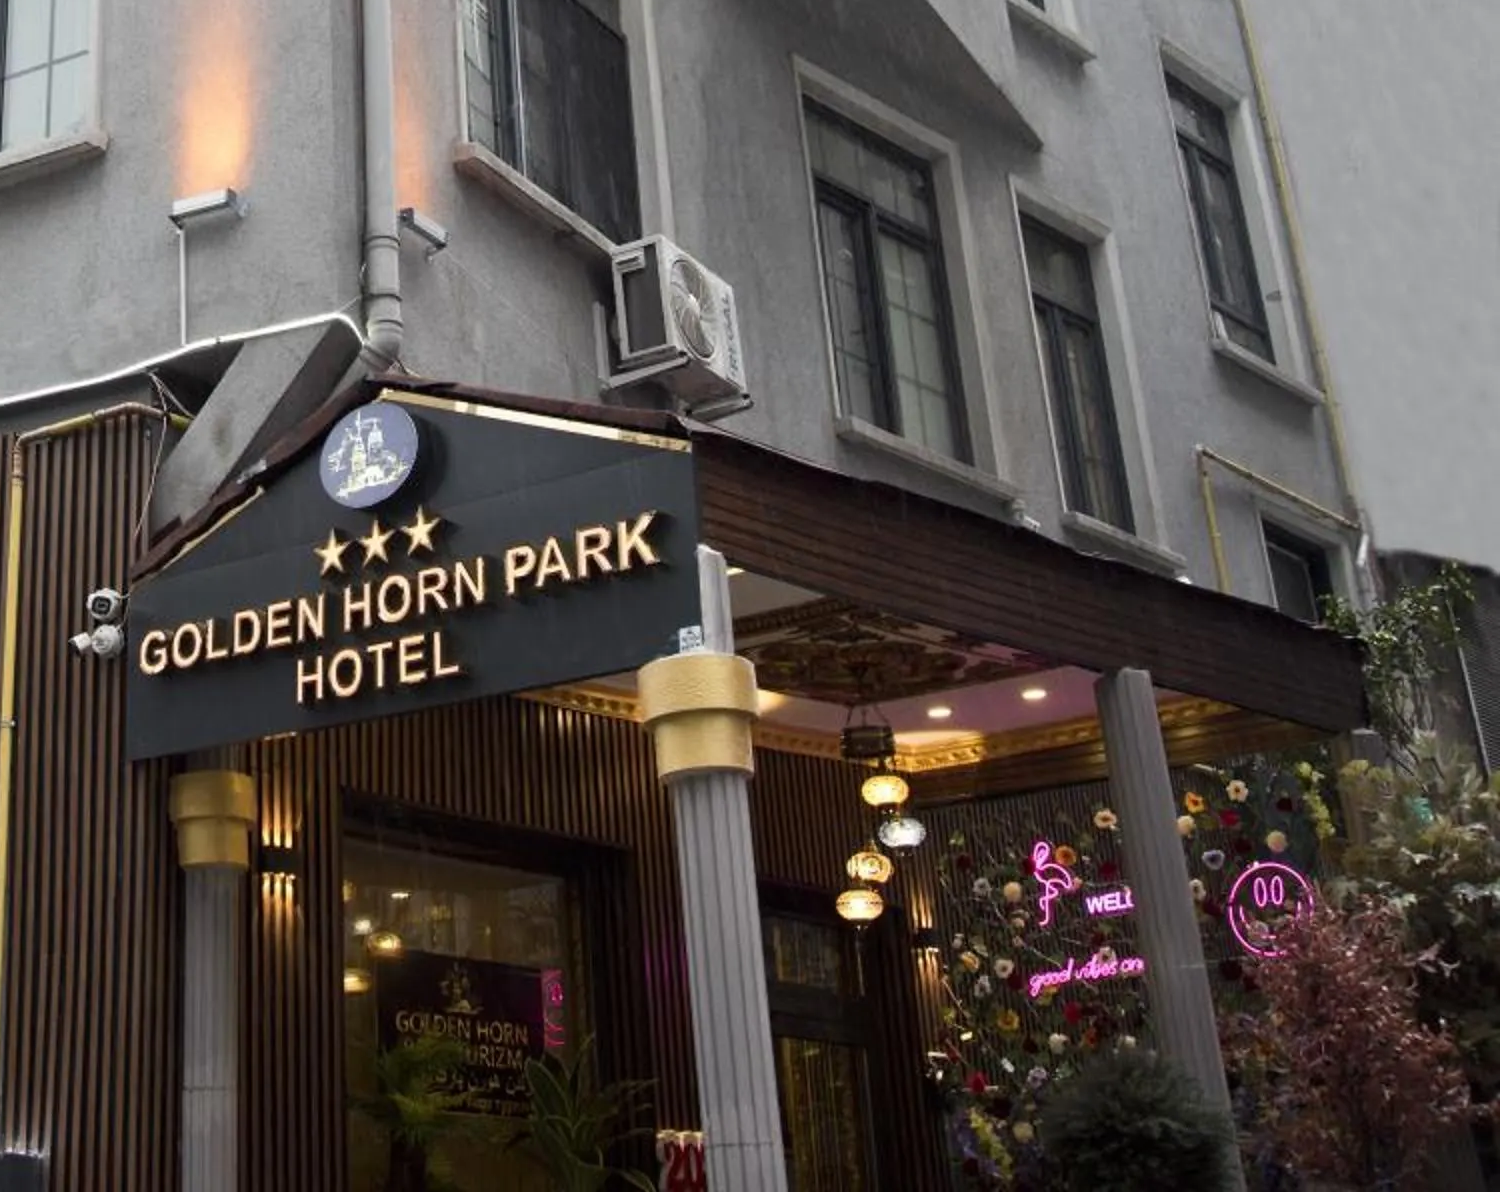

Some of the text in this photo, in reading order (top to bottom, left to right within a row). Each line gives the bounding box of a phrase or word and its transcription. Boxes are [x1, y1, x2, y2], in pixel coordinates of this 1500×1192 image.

[139, 510, 660, 675] GOLDEN HORN PARK
[296, 631, 460, 702] HOTEL
[1030, 957, 1074, 997] good
[395, 1011, 529, 1047] GOLDEN HORN
